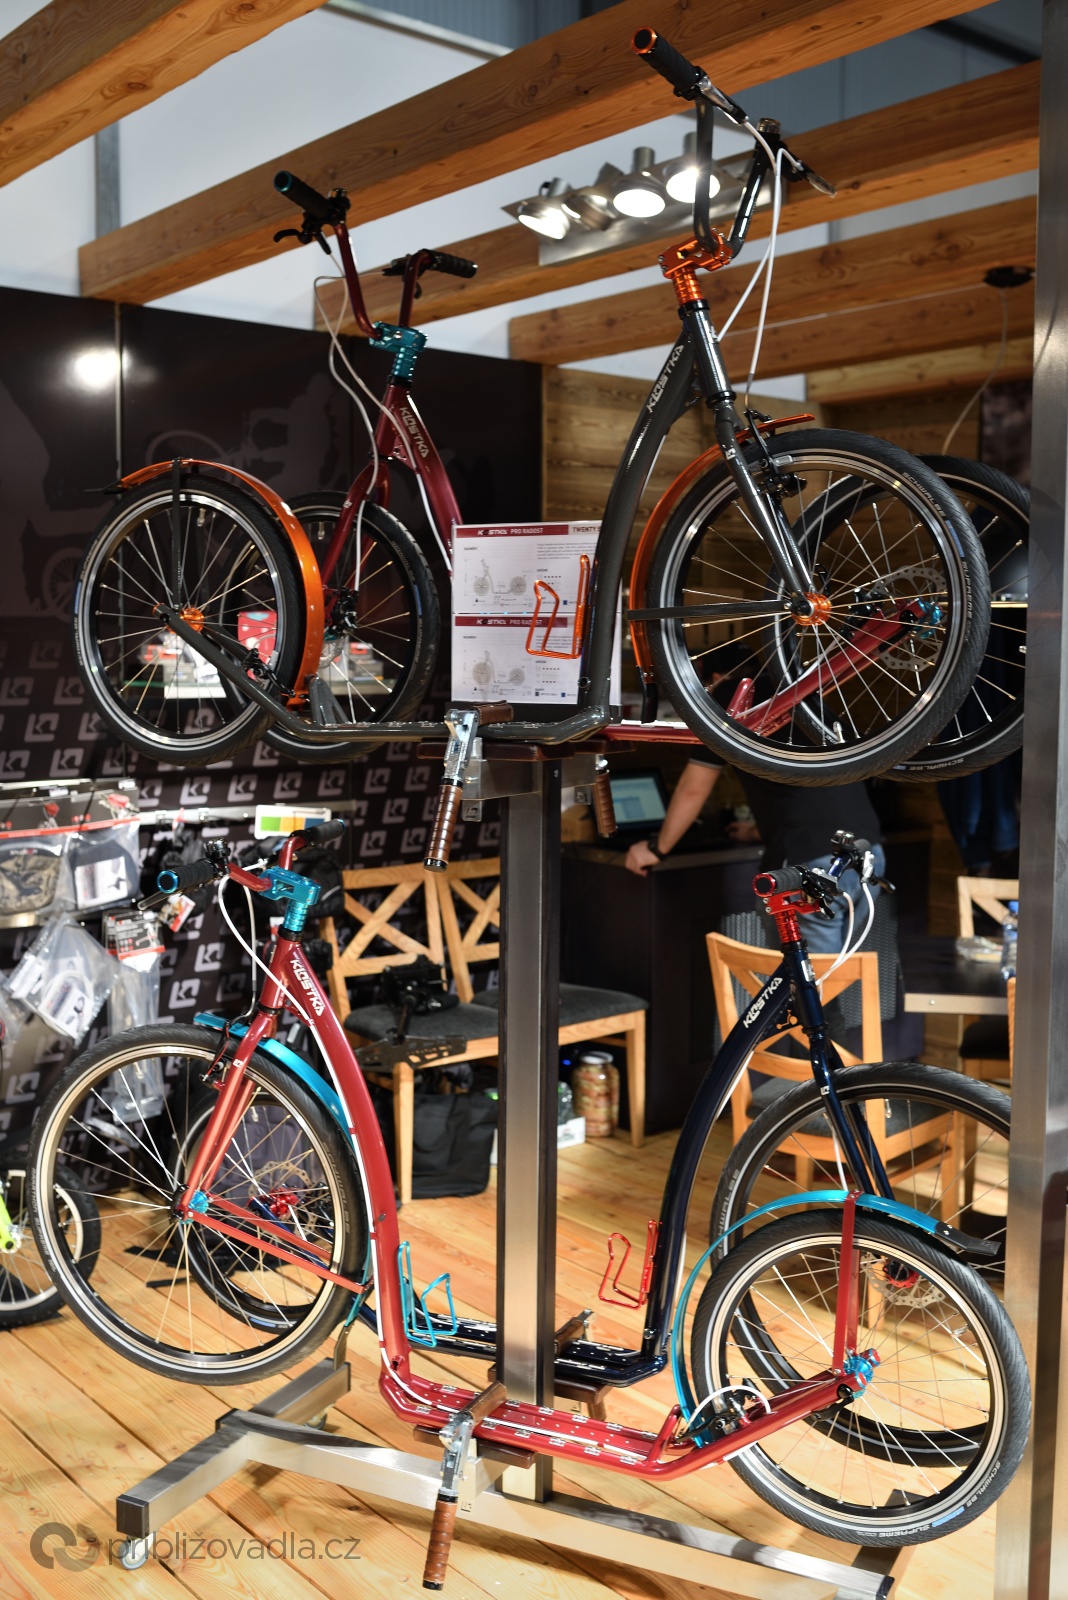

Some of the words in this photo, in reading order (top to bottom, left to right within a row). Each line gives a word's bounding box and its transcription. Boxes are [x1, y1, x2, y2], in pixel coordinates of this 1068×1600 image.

[902, 471, 946, 518] SCHWALBE
[909, 757, 965, 771] SCHWALBE
[290, 959, 326, 1016] KOSTKA
[743, 977, 784, 1029] KOSTKA
[966, 1460, 1001, 1508] SCHWALBE
[878, 1524, 930, 1538] SUPREME
